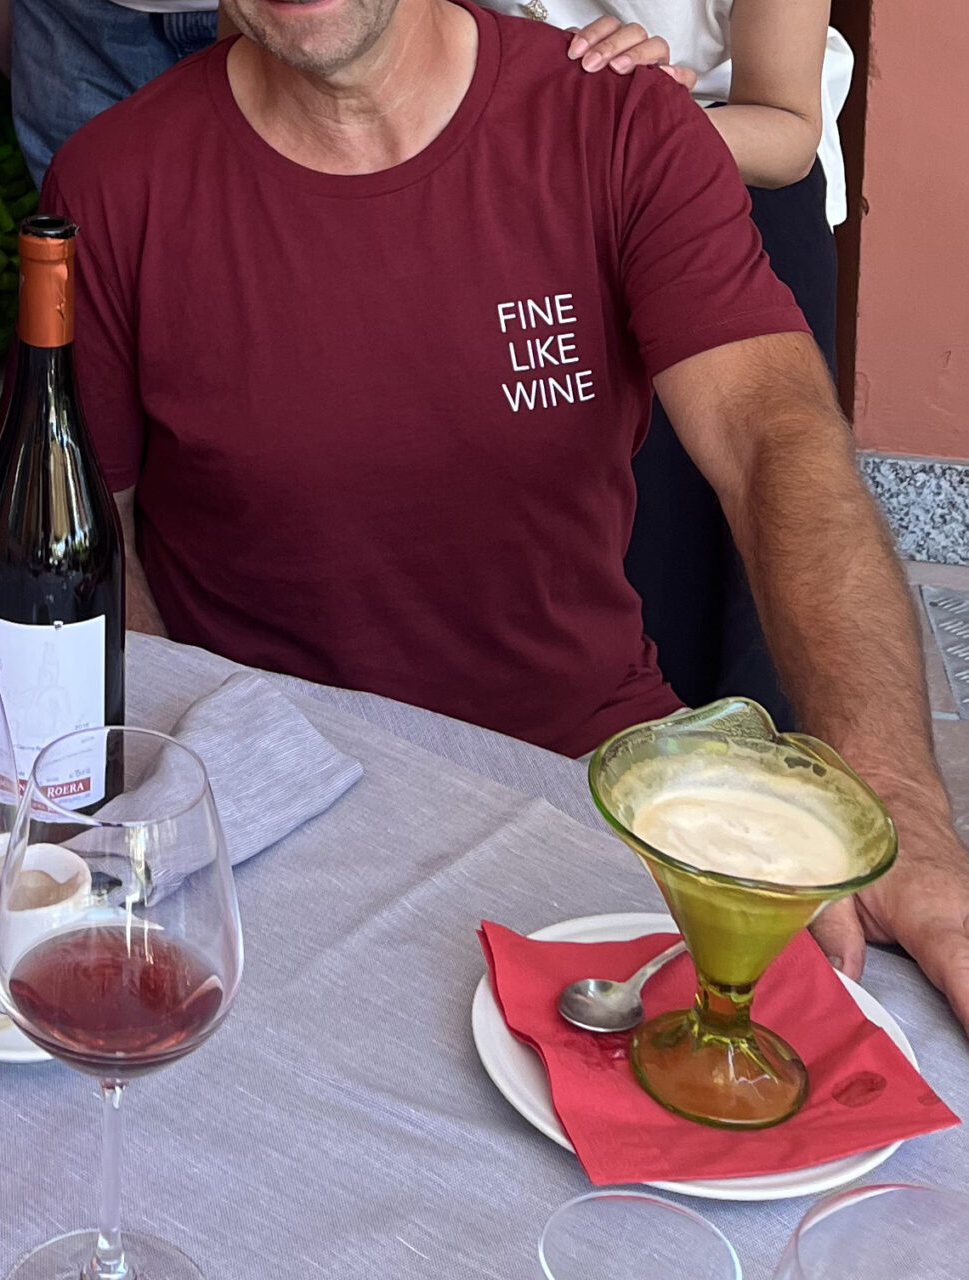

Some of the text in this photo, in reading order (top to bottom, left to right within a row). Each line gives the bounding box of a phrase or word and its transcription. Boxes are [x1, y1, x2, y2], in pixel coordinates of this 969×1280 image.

[497, 294, 577, 333] FINE
[509, 333, 579, 371] LIKE
[502, 370, 595, 412] WINE
[47, 782, 84, 798] ROERA
